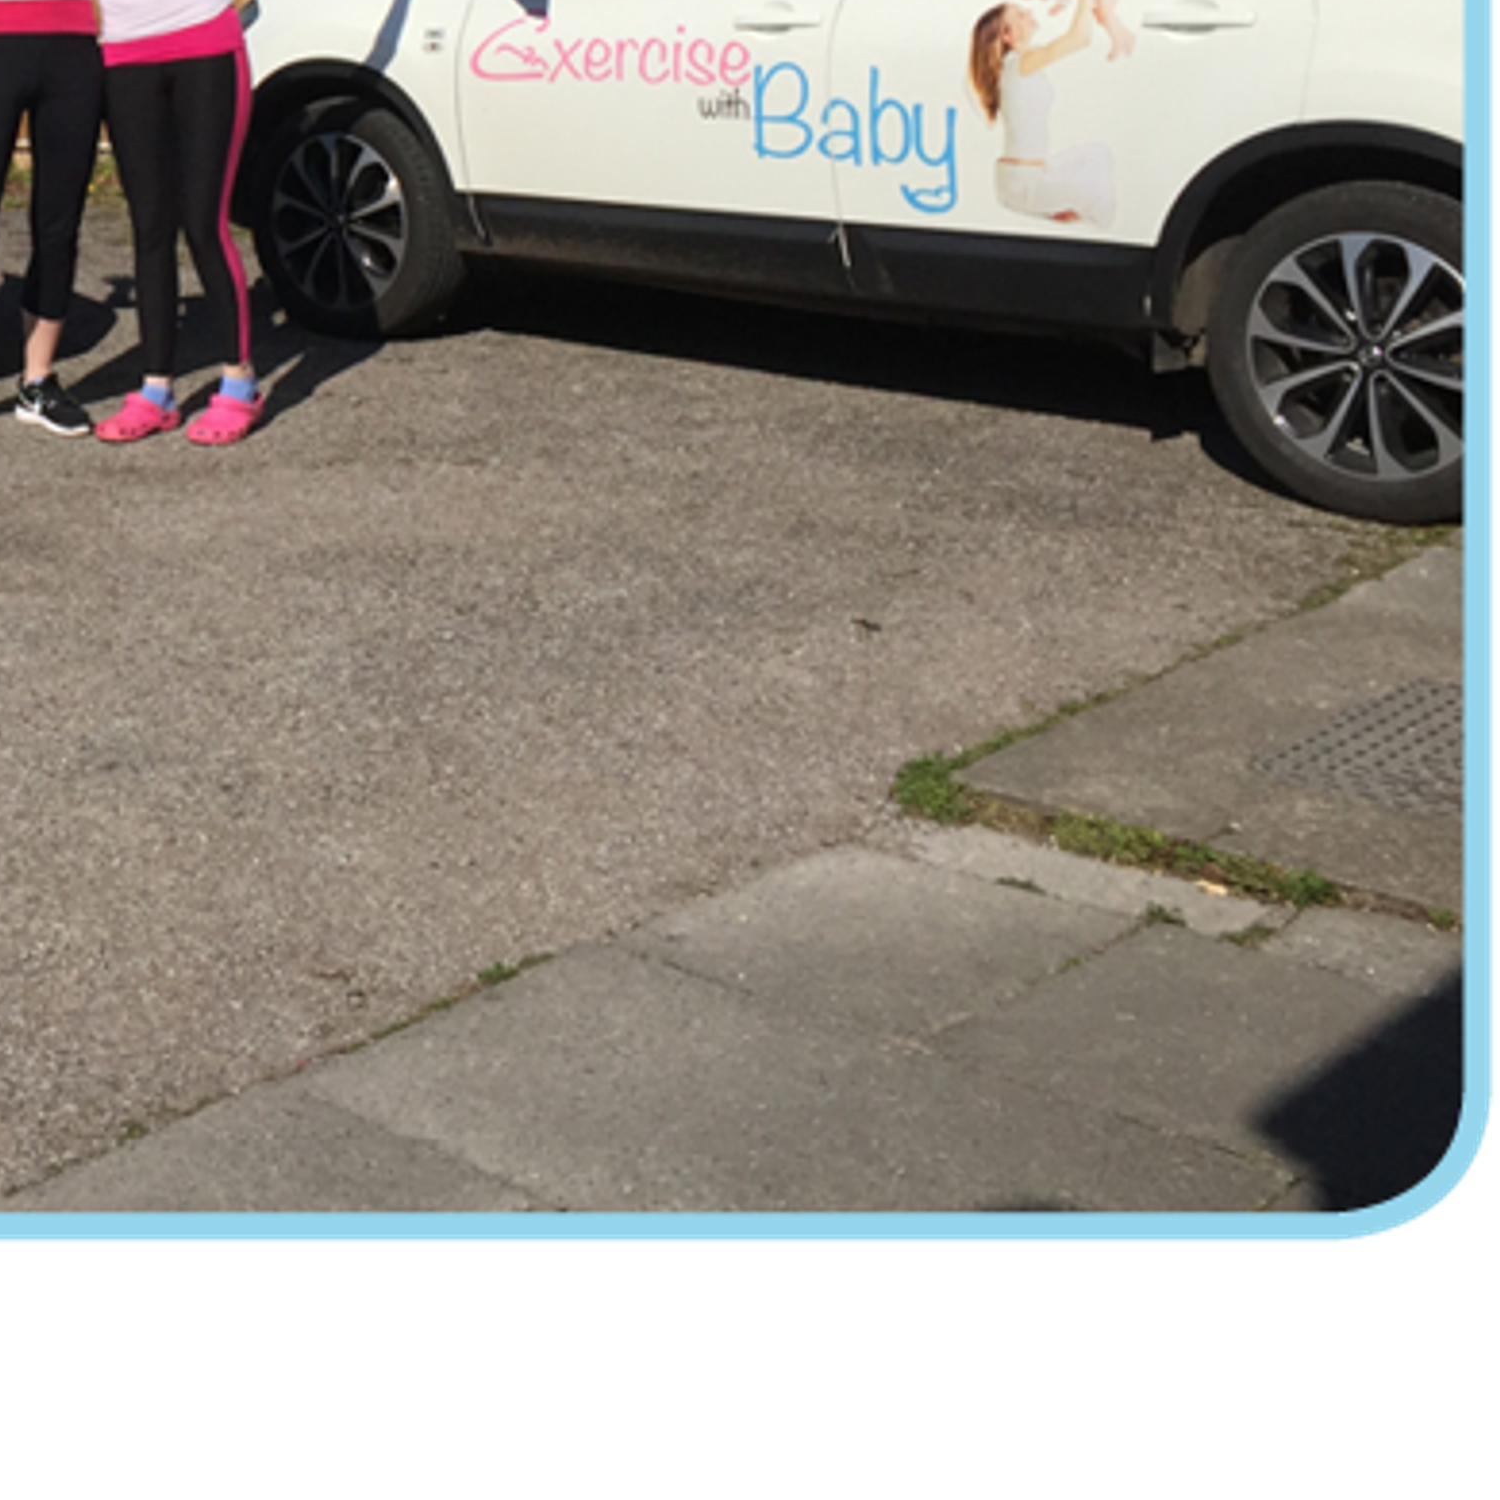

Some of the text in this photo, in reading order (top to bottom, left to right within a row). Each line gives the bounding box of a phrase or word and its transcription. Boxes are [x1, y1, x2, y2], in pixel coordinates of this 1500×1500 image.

[469, 14, 752, 87] Exercise
[698, 61, 958, 215] with Baby
